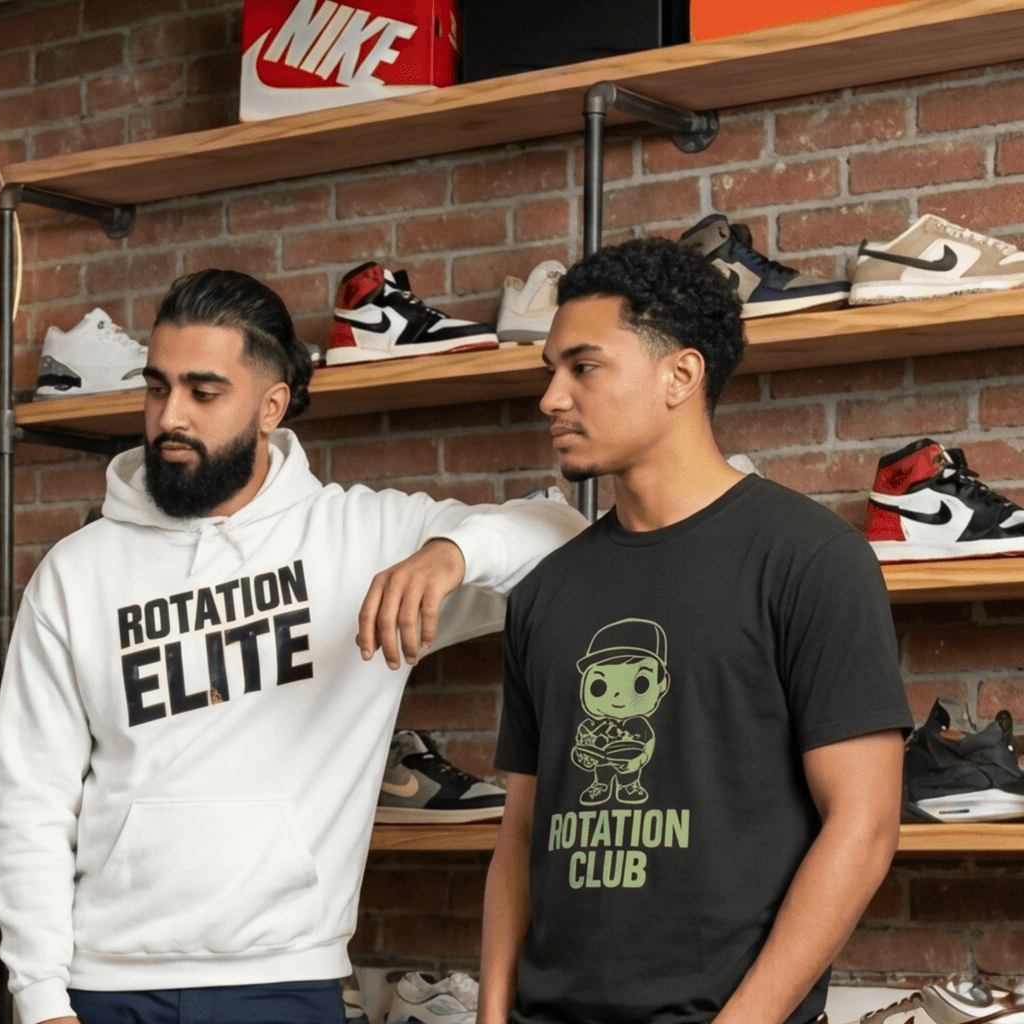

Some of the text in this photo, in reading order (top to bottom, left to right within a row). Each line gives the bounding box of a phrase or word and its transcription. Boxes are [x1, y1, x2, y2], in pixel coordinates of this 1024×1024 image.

[263, 0, 418, 86] NIKE
[118, 559, 309, 649] ROTATION
[121, 607, 314, 728] ELITE
[548, 809, 690, 851] ROTATION
[569, 850, 647, 889] CLUB
